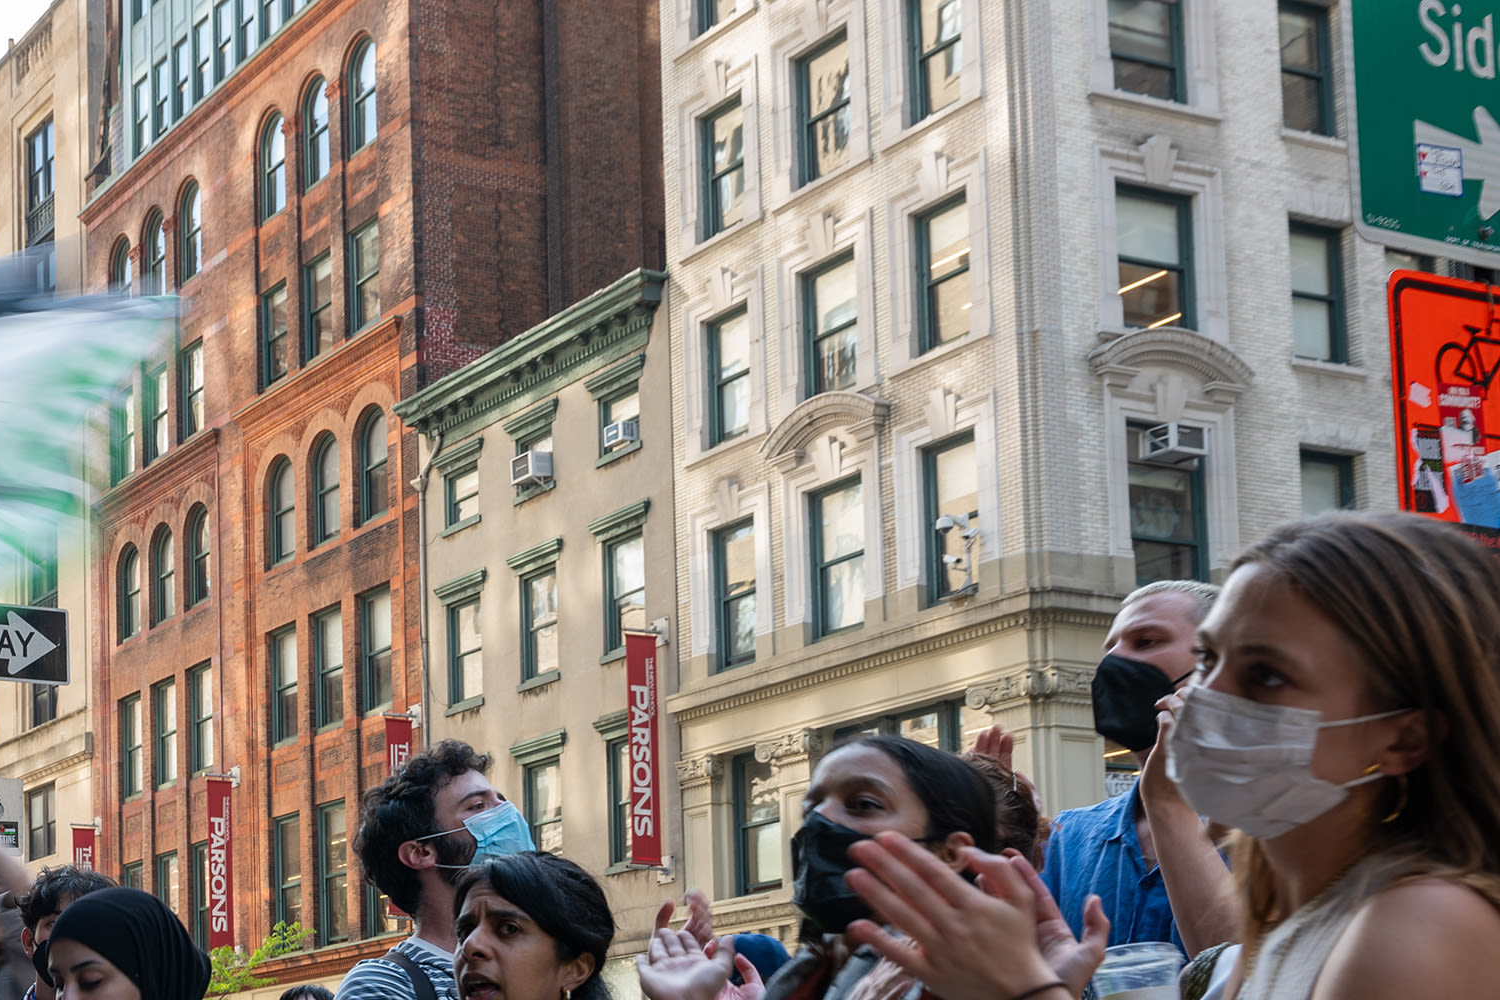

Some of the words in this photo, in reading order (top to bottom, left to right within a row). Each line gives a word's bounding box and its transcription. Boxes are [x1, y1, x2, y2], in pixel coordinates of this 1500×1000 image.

[1418, 0, 1500, 80] Sid
[398, 741, 409, 766] TH
[630, 684, 653, 837] PARSONS
[210, 816, 228, 933] PARSONS
